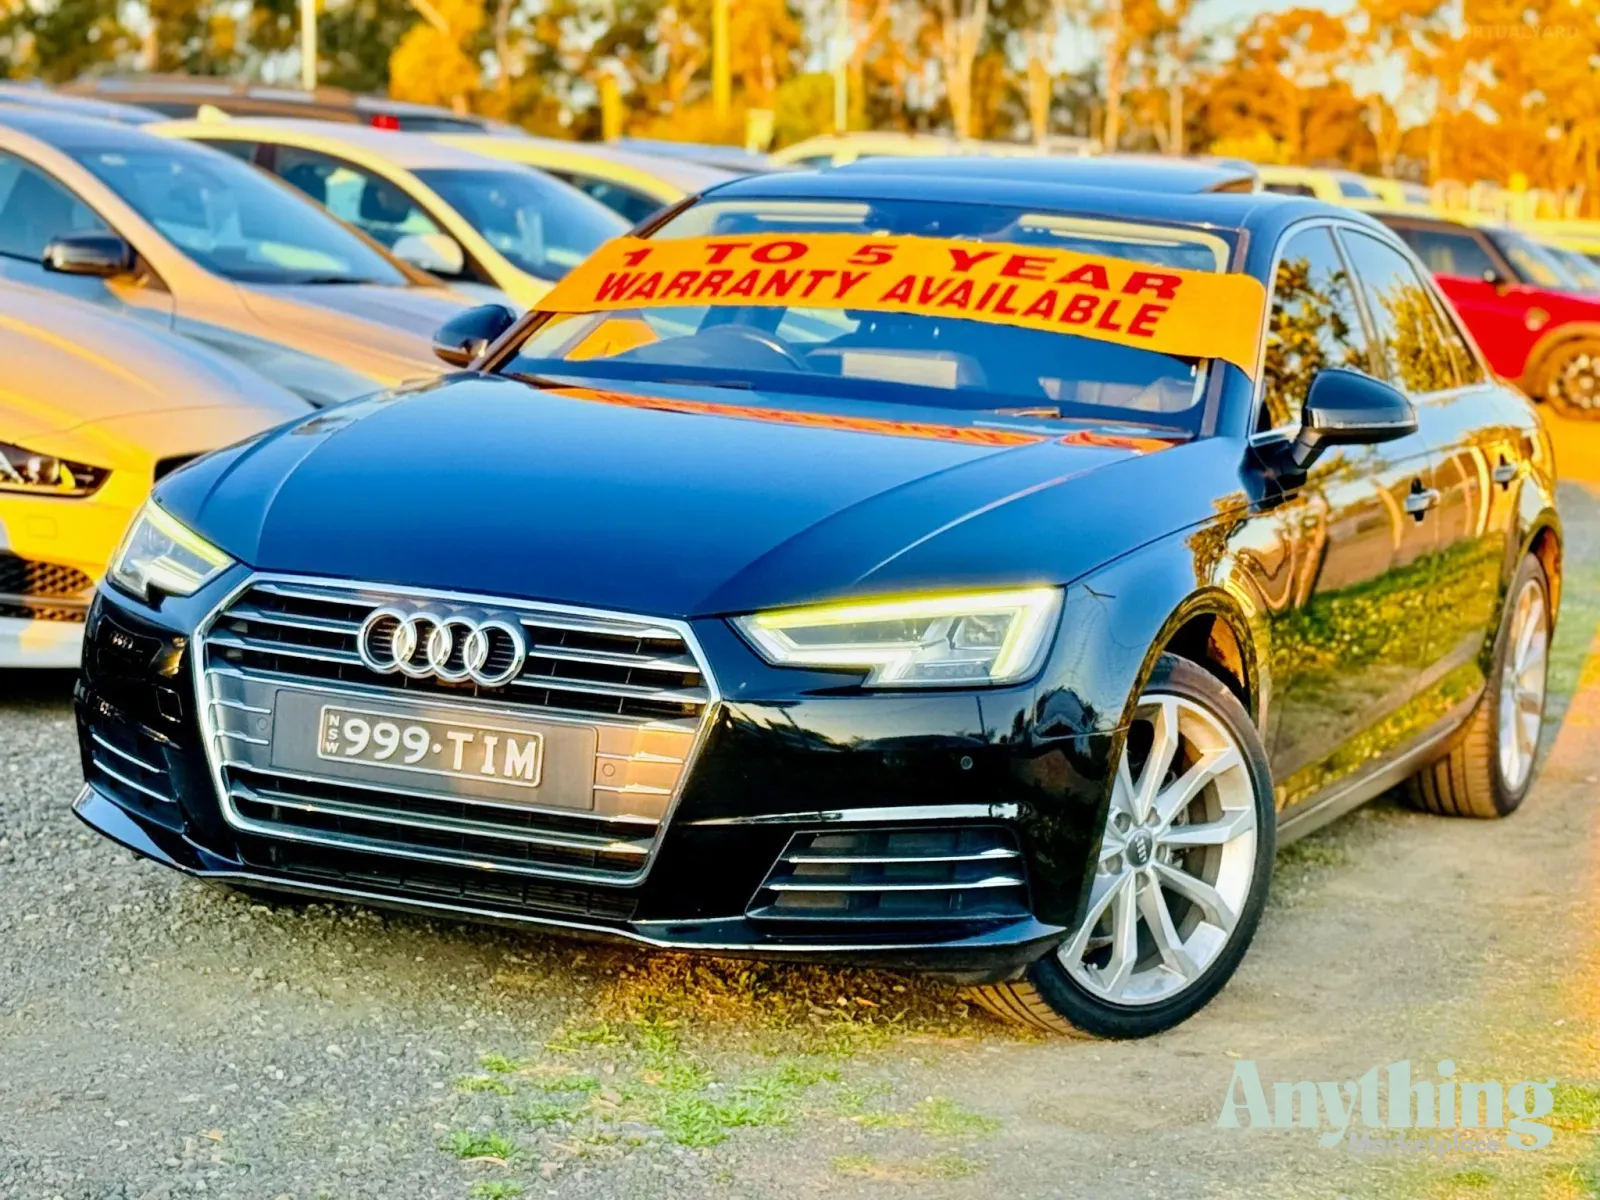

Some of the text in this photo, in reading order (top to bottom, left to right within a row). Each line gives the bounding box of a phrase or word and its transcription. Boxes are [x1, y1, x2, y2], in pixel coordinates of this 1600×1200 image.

[623, 241, 1184, 300] 1 TO 5 YEAR
[594, 269, 1169, 338] WARRANTY AVAILABLE
